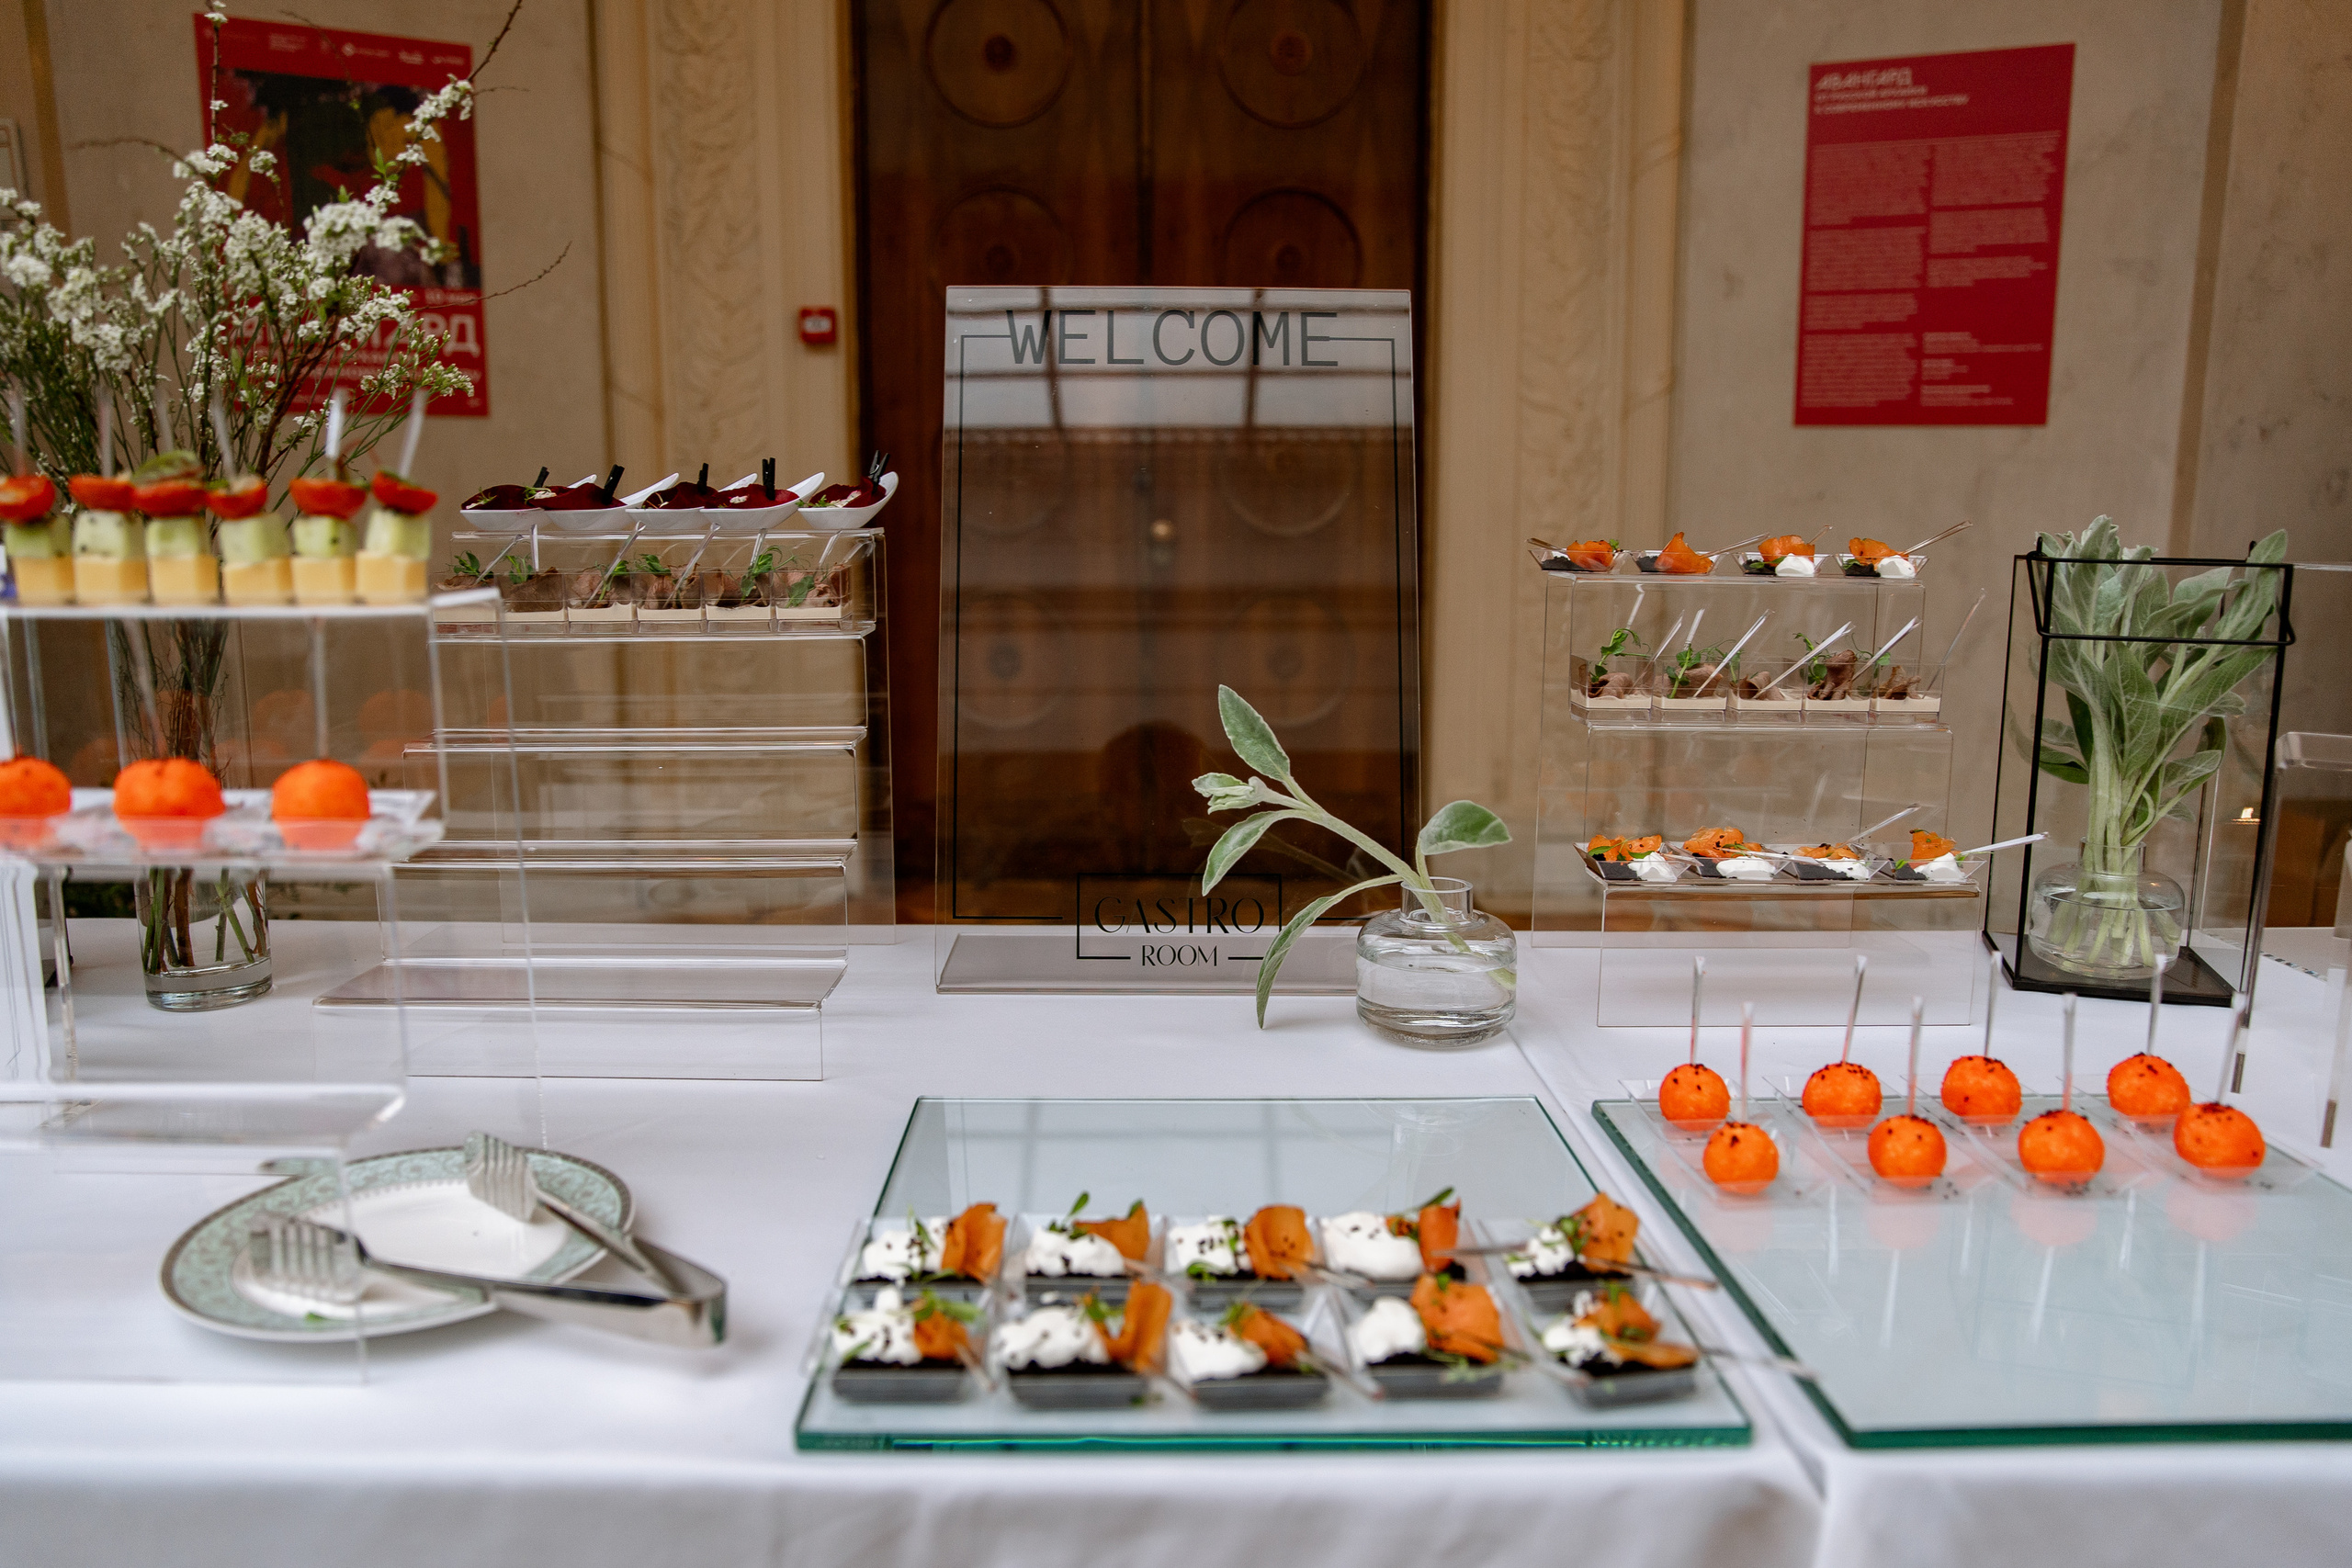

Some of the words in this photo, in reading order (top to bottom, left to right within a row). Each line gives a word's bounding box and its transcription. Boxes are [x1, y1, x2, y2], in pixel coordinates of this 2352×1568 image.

[1006, 310, 1339, 367] WELCOME
[1093, 896, 1265, 934] GASTRO
[1142, 944, 1217, 966] ROOM
